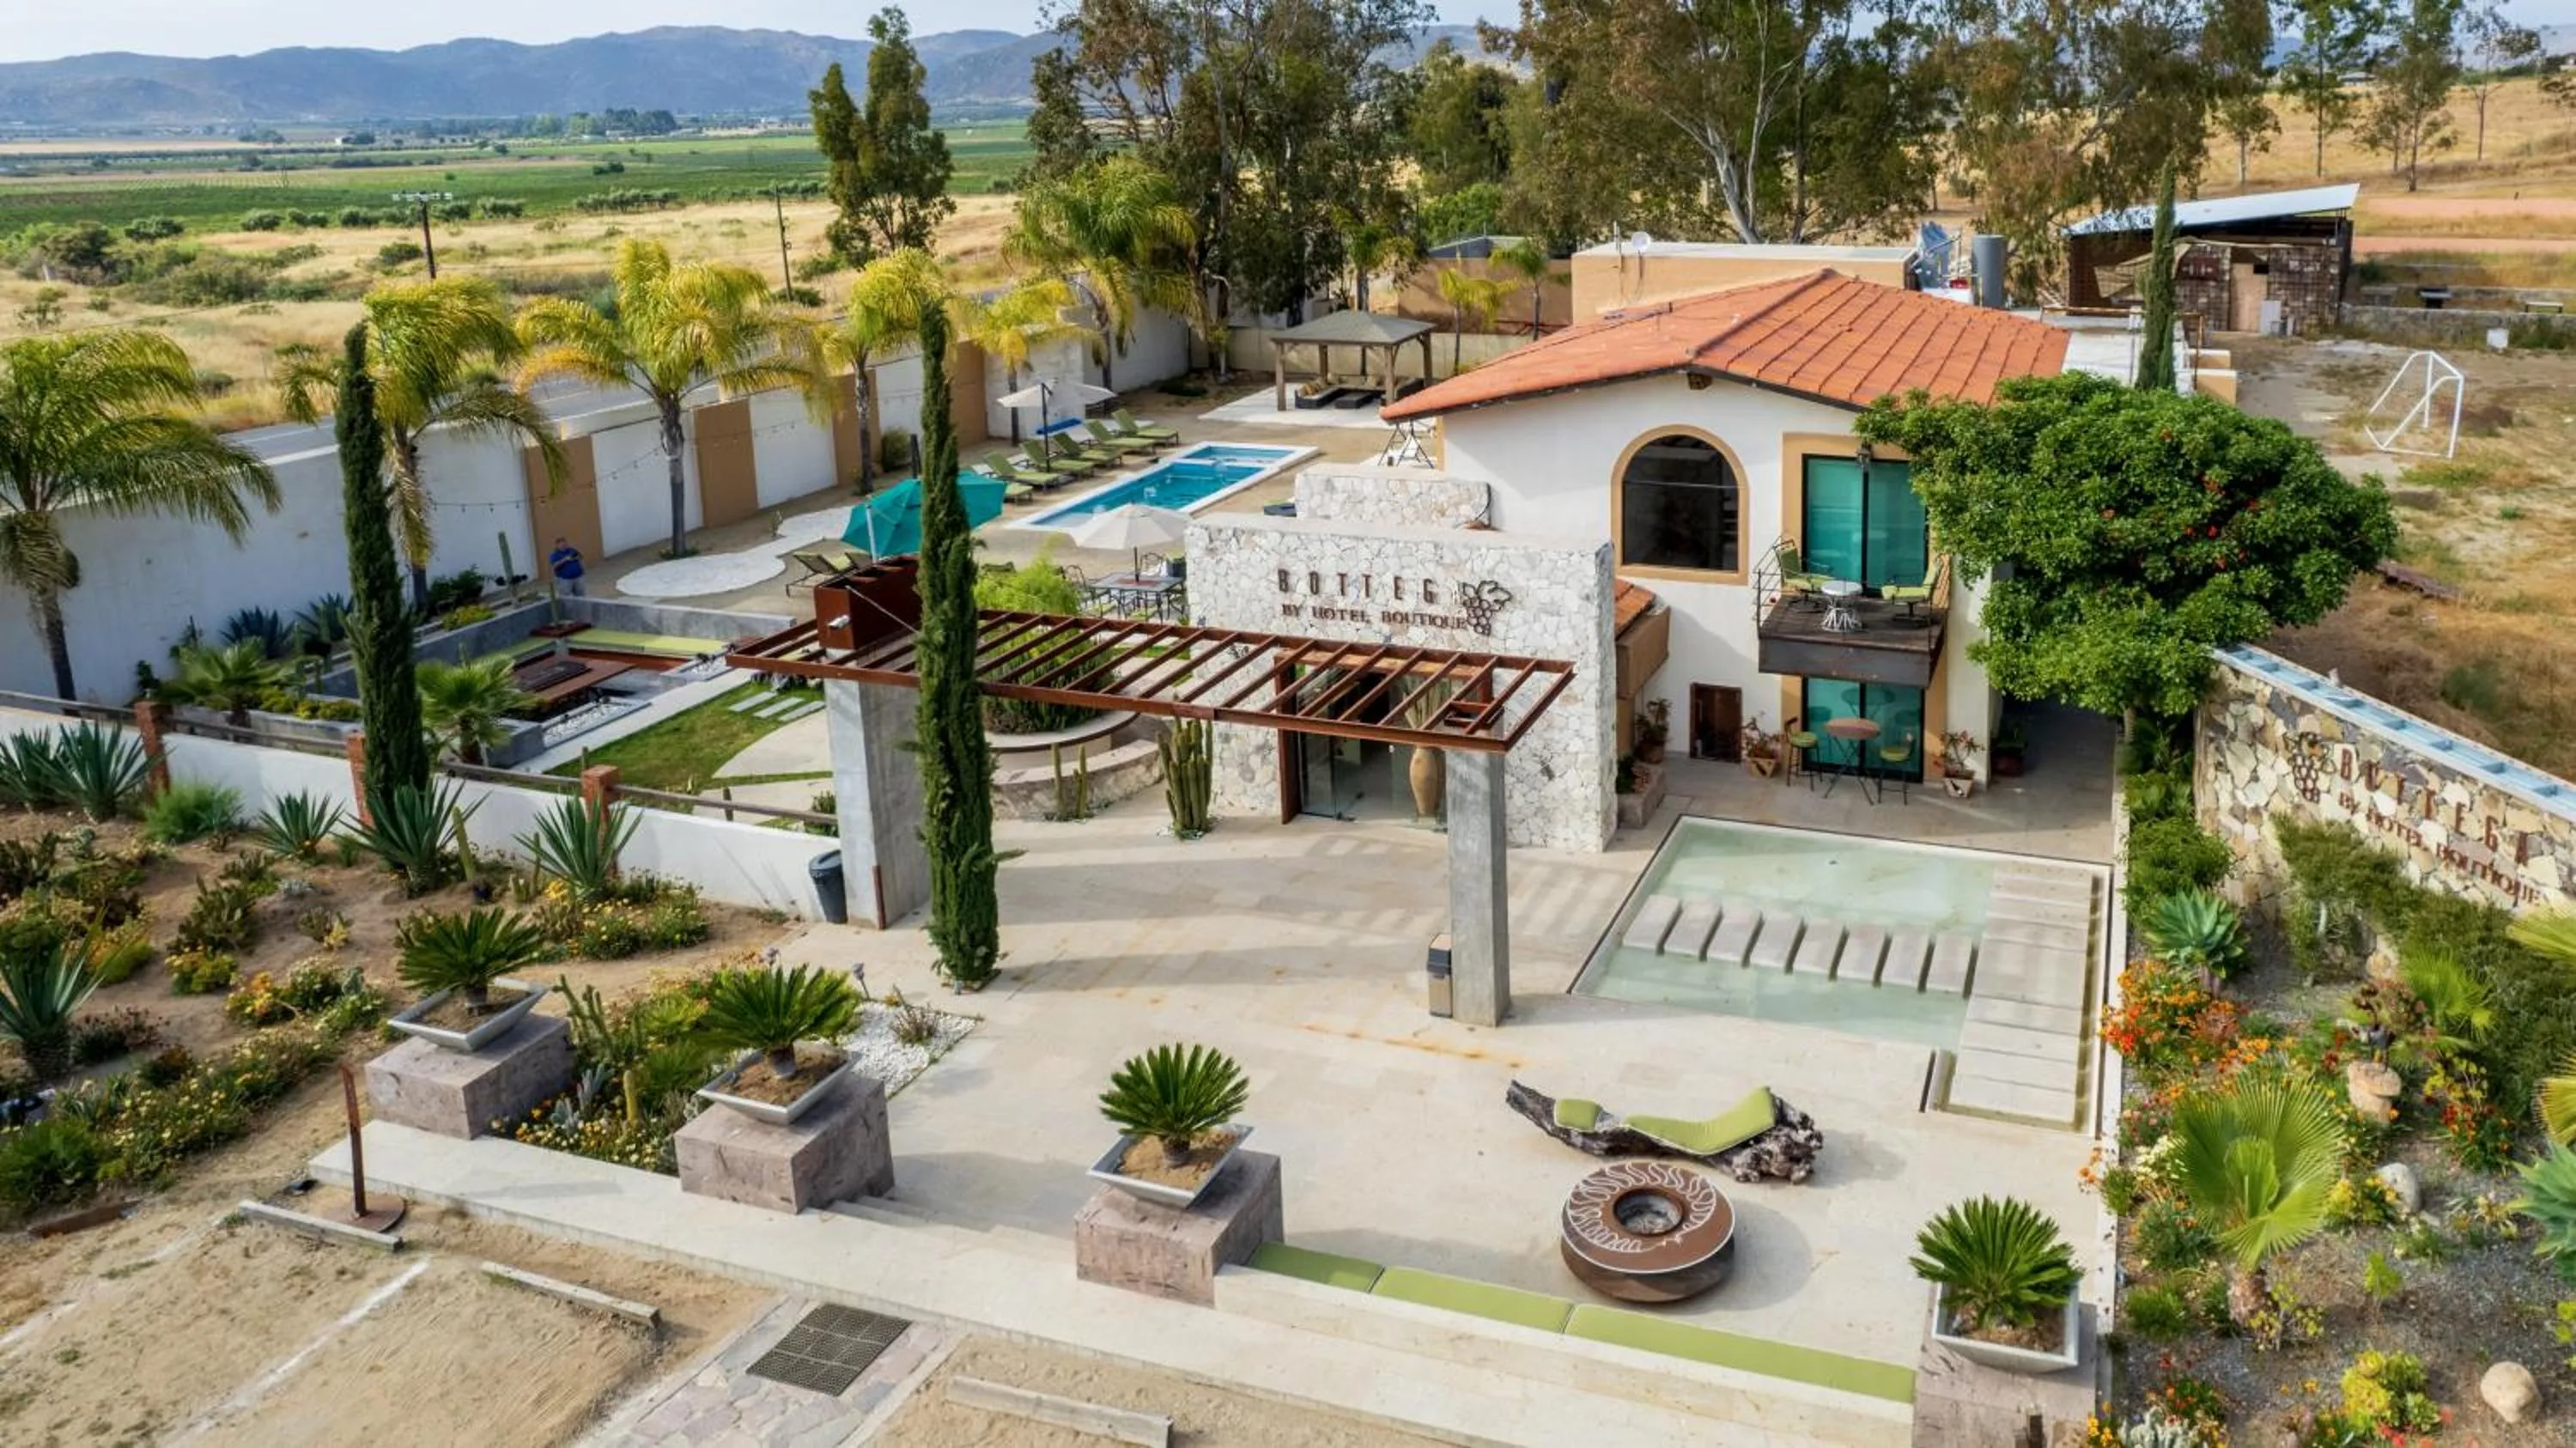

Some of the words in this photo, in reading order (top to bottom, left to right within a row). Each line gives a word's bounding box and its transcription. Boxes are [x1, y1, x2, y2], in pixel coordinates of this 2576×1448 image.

[1282, 604, 1301, 617] BY
[1312, 605, 1371, 624] HOTEL
[1381, 611, 1467, 630] BOUTIQUE
